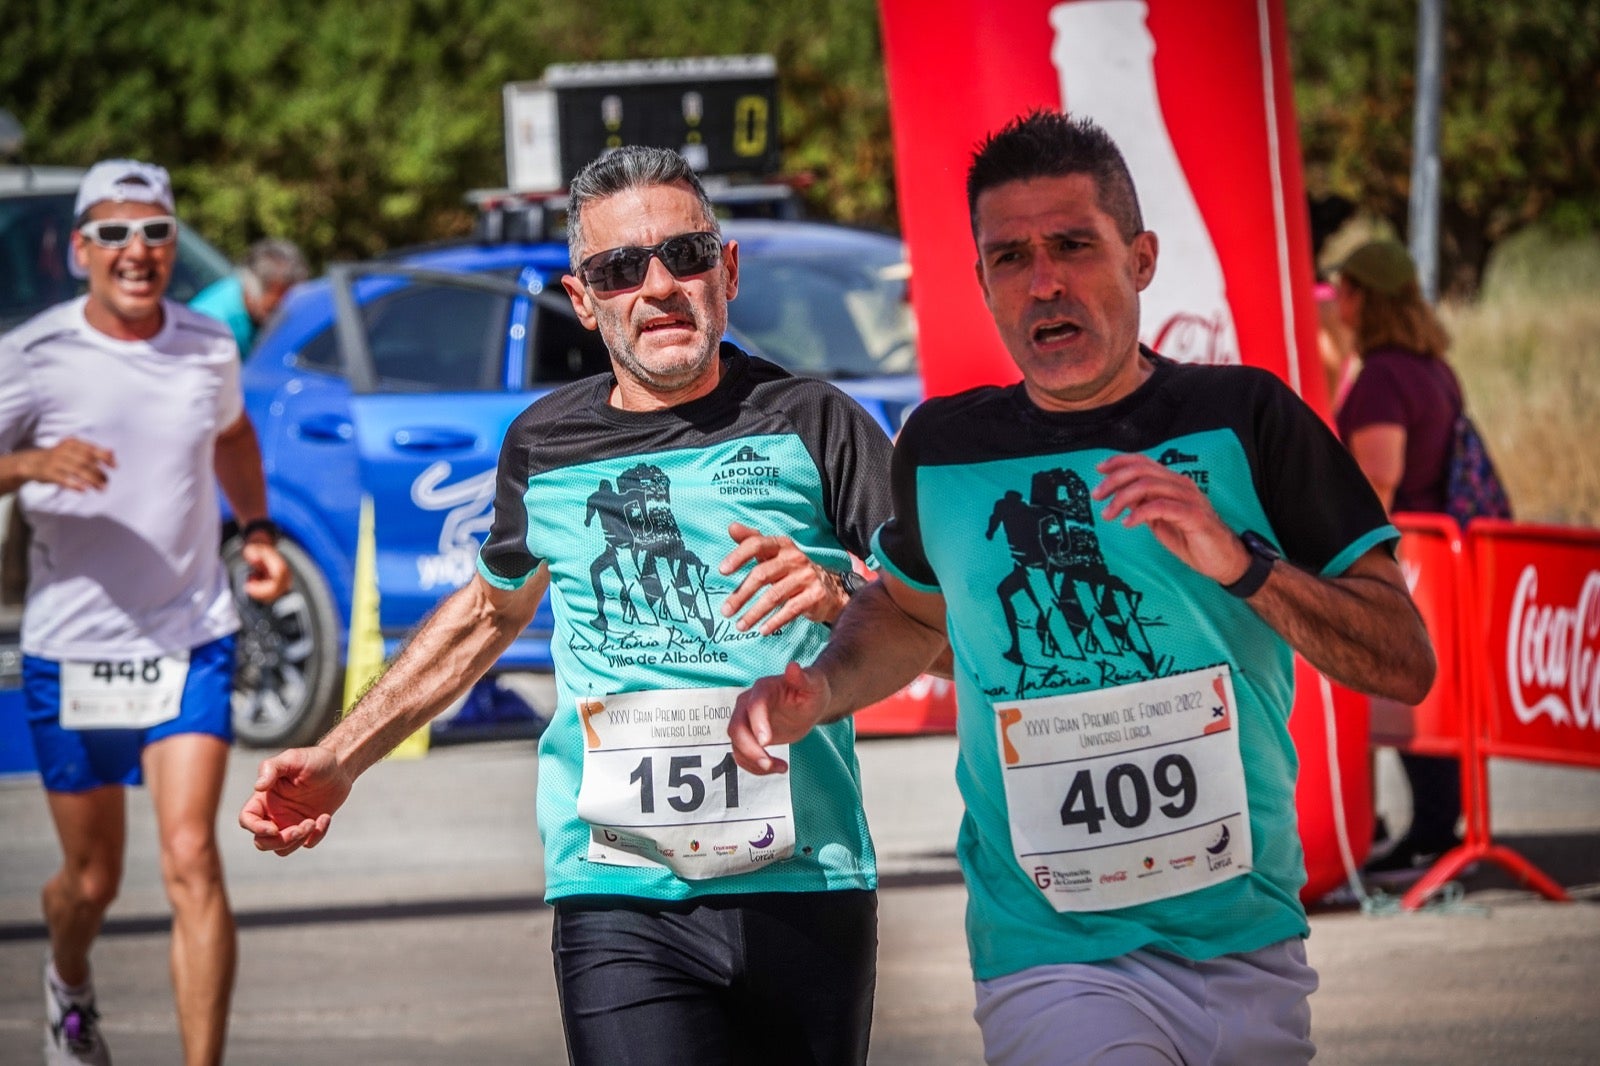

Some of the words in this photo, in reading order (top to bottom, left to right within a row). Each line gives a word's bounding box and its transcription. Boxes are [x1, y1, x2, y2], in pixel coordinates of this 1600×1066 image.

[734, 95, 769, 157] 0
[712, 466, 780, 481] ALBOLOTE
[720, 487, 770, 495] DEPORTES
[606, 654, 635, 668] Villa
[637, 654, 657, 664] de
[661, 652, 729, 664] Albolote
[607, 710, 630, 725] XXXV
[1025, 720, 1050, 737] XXXV
[1175, 691, 1203, 713] 2022
[629, 752, 740, 814] 151
[1060, 753, 1198, 835] 409
